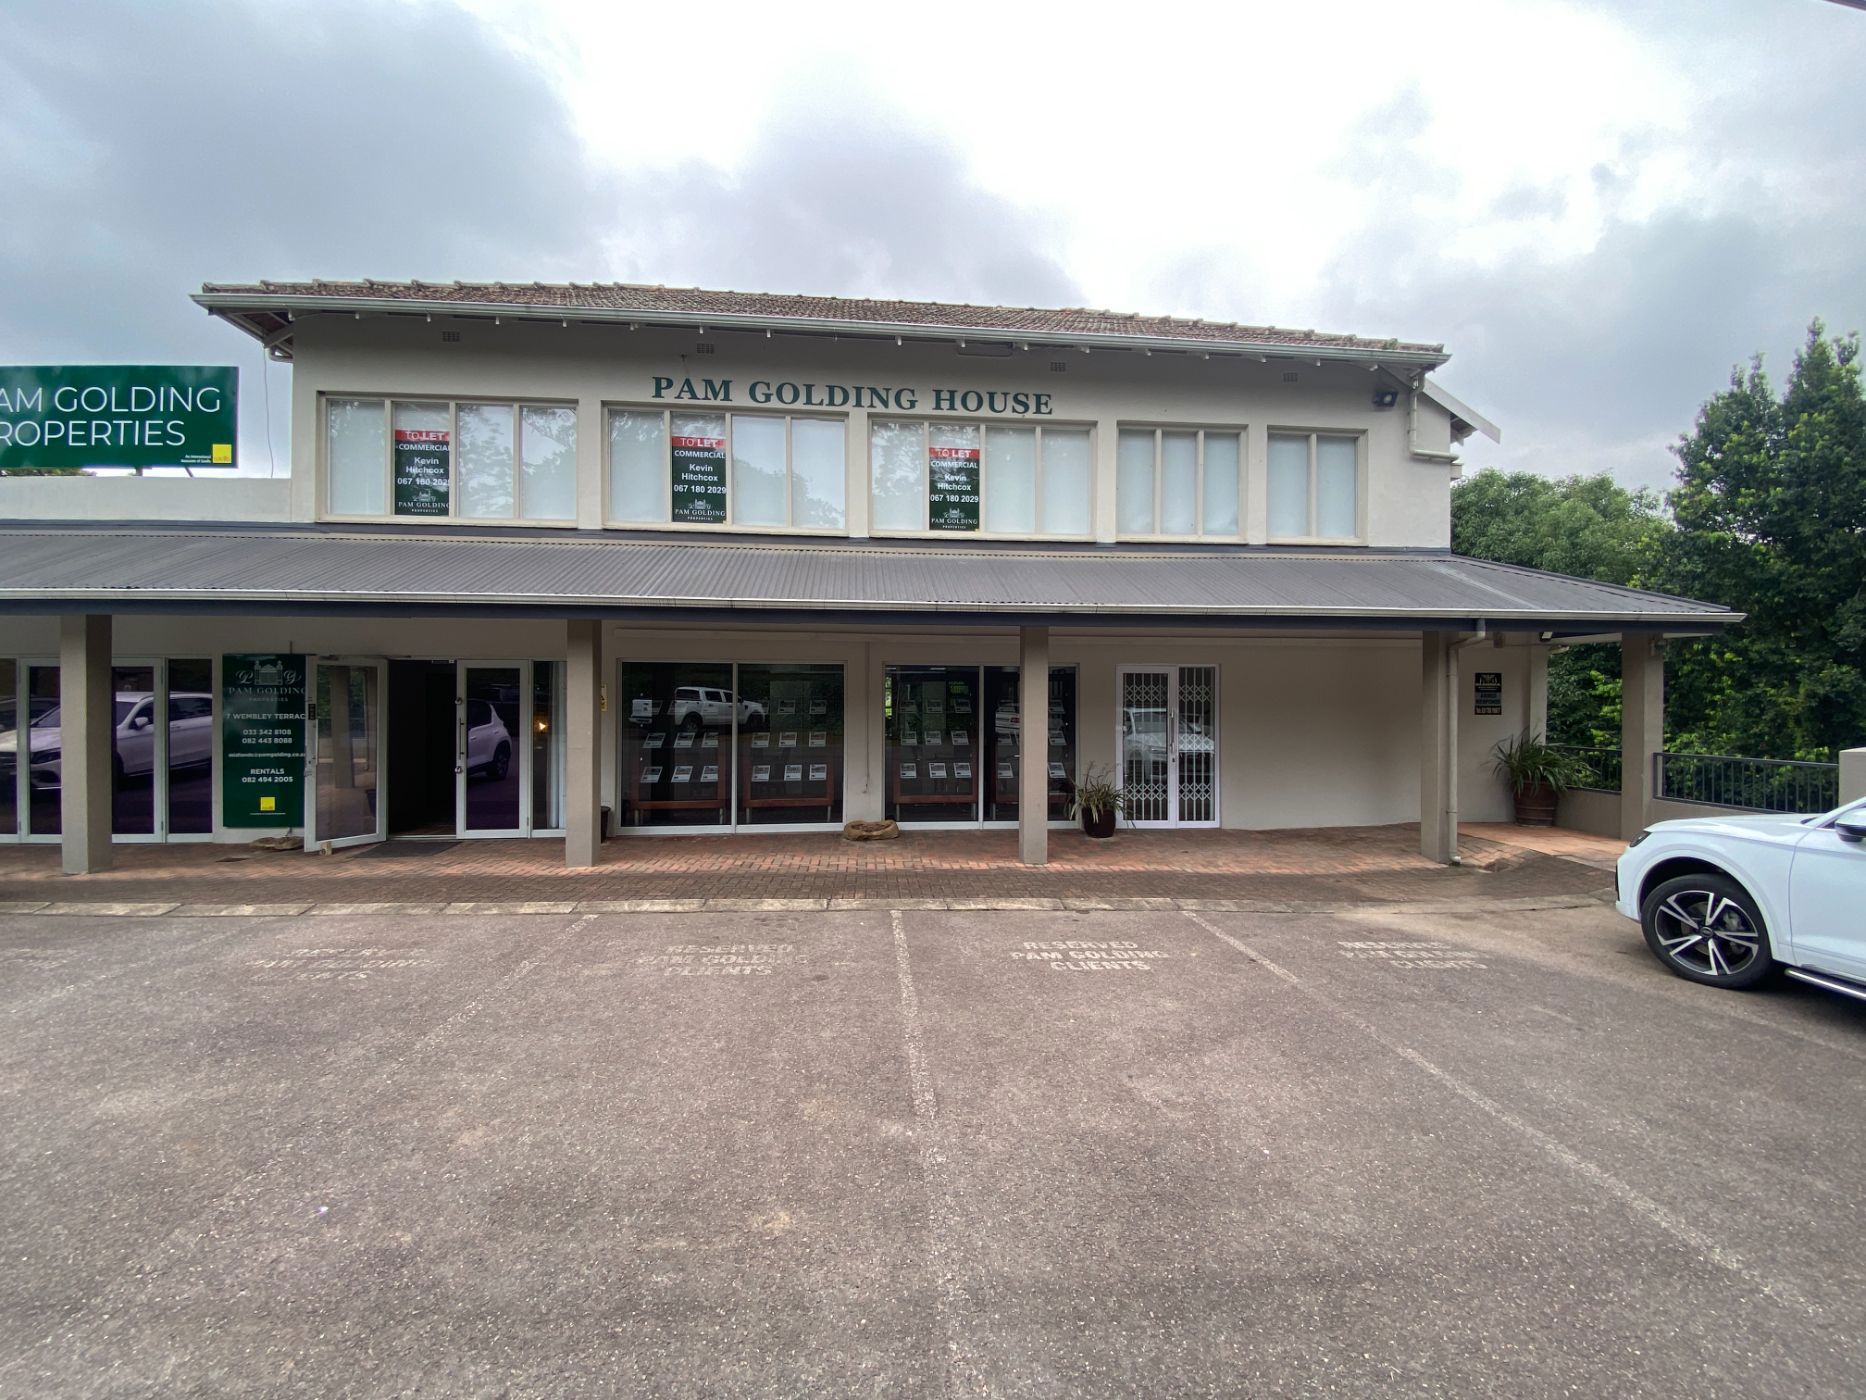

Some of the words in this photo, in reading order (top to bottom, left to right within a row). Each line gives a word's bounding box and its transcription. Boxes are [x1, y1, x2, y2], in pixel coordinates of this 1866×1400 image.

[54, 386, 221, 413] GOLDING
[652, 376, 733, 402] PAM
[748, 380, 919, 410] GOLDING
[932, 389, 1053, 415] HOUSE
[406, 431, 420, 440] TO
[420, 432, 445, 441] LET
[680, 438, 695, 447] TO
[674, 450, 725, 459] COMMERCIAL
[952, 449, 971, 458] LET
[414, 457, 439, 465] Kevin
[689, 464, 713, 472] Kevin
[681, 473, 718, 481] Hitchcox
[944, 473, 967, 481] Kevin
[691, 485, 705, 493] 180
[707, 486, 727, 494] 2029
[930, 494, 943, 502] 067
[1023, 941, 1139, 950] RESERVED
[1009, 951, 1063, 960] PAM
[1068, 951, 1169, 959] GOLDING
[1050, 960, 1152, 970] CLIENTS
